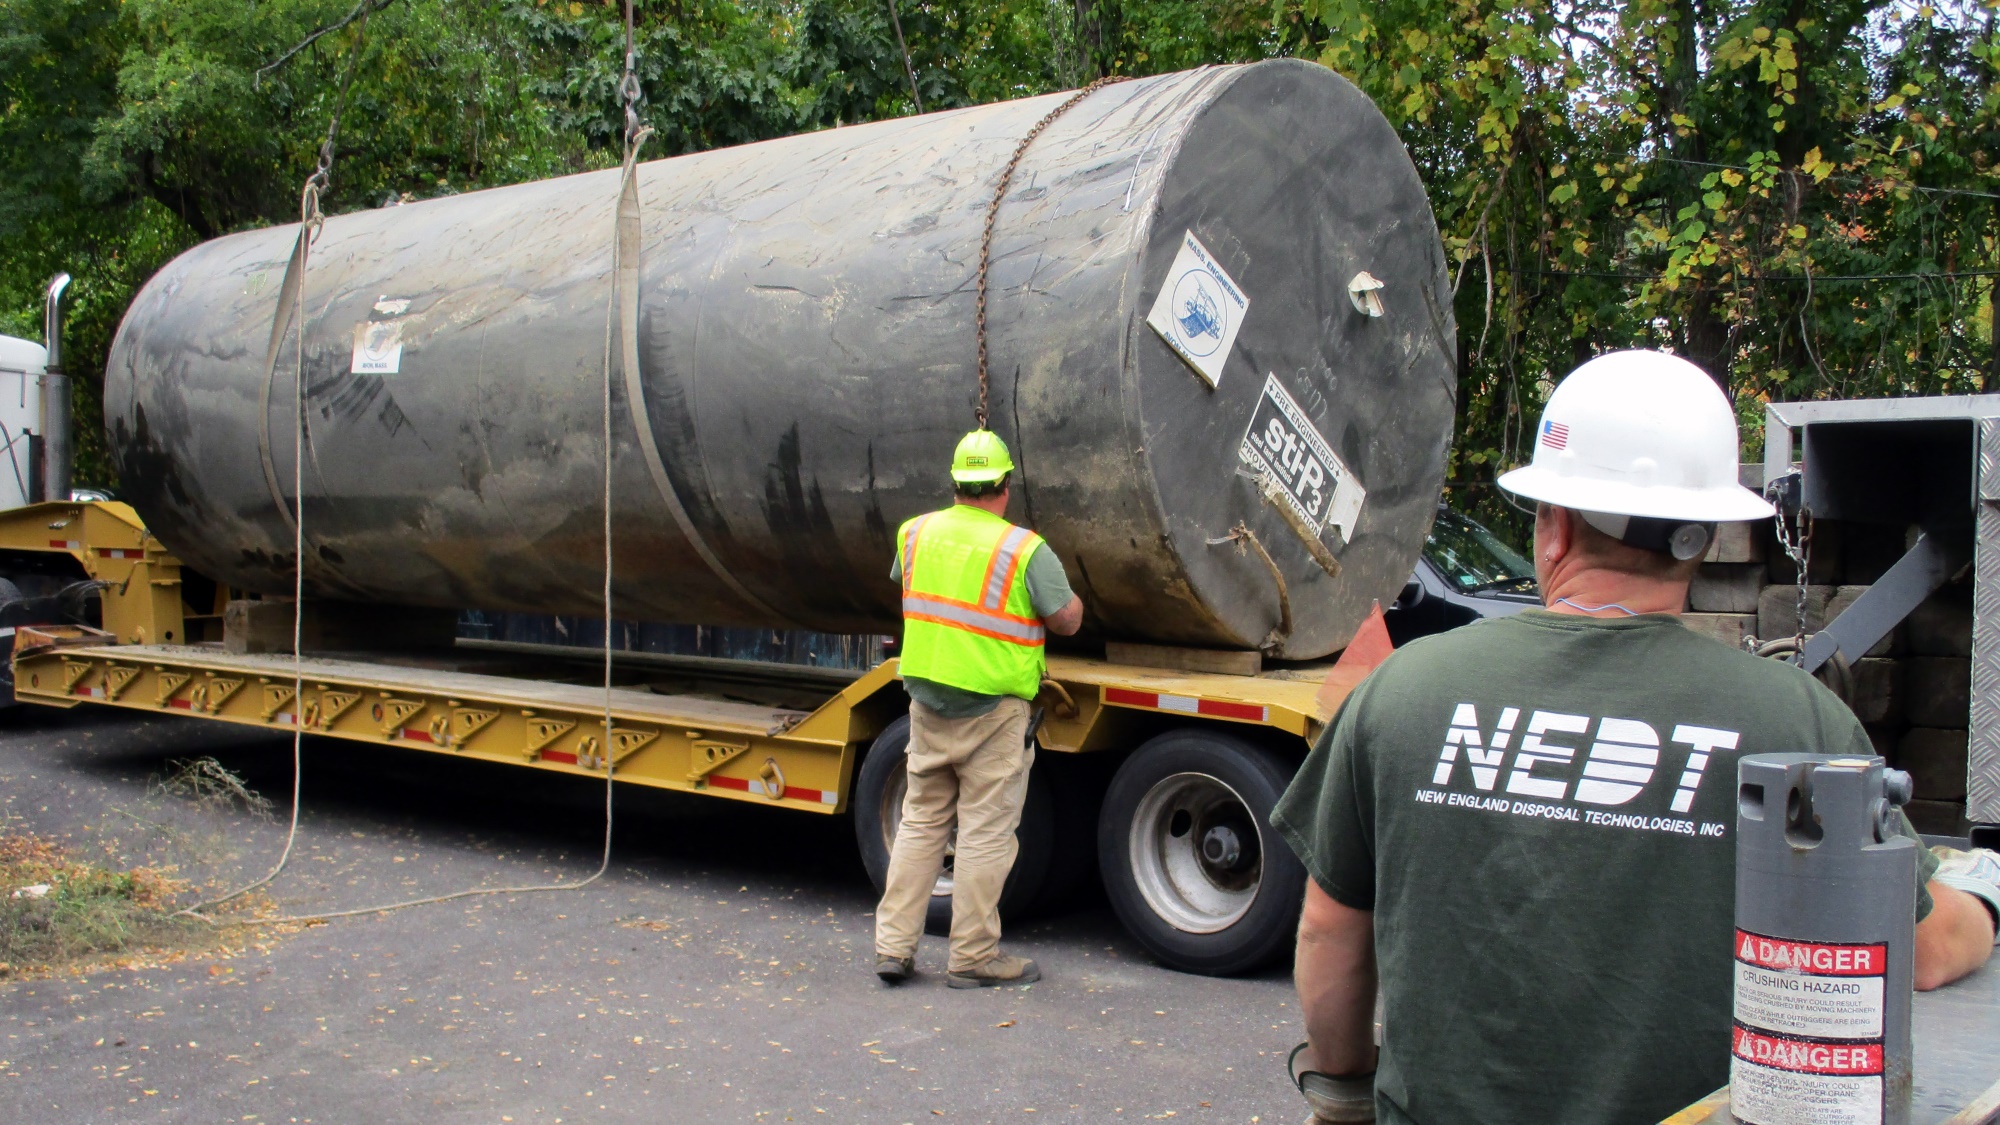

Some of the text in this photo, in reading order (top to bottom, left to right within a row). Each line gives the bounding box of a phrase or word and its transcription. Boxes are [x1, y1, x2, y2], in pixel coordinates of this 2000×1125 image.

[1187, 238, 1245, 309] MASS. ENGINEERING
[1274, 391, 1335, 475] PRE-ENGINEERED
[1251, 431, 1293, 485] steel tank institute
[1432, 703, 1740, 813] NEDT
[1415, 789, 1725, 837] NEW ENGLAND DISPOSAL TECHNOLOGIES, INC
[1759, 941, 1870, 970] DANGER
[1743, 970, 1860, 994] CRUSHING HAZARD
[1757, 991, 1782, 1001] SERIOUS
[1782, 996, 1807, 1004] INJURY
[1809, 999, 1835, 1007] COULD
[1763, 999, 1794, 1010] CRUSHED
[1806, 1005, 1835, 1013] MOVING
[1748, 1006, 1766, 1015] CLEAR
[1766, 1010, 1786, 1019] WHILE
[1786, 1013, 1833, 1025] OUTRIGGERS
[1756, 1039, 1869, 1069] DANGER
[1832, 1082, 1860, 1090] COULD
